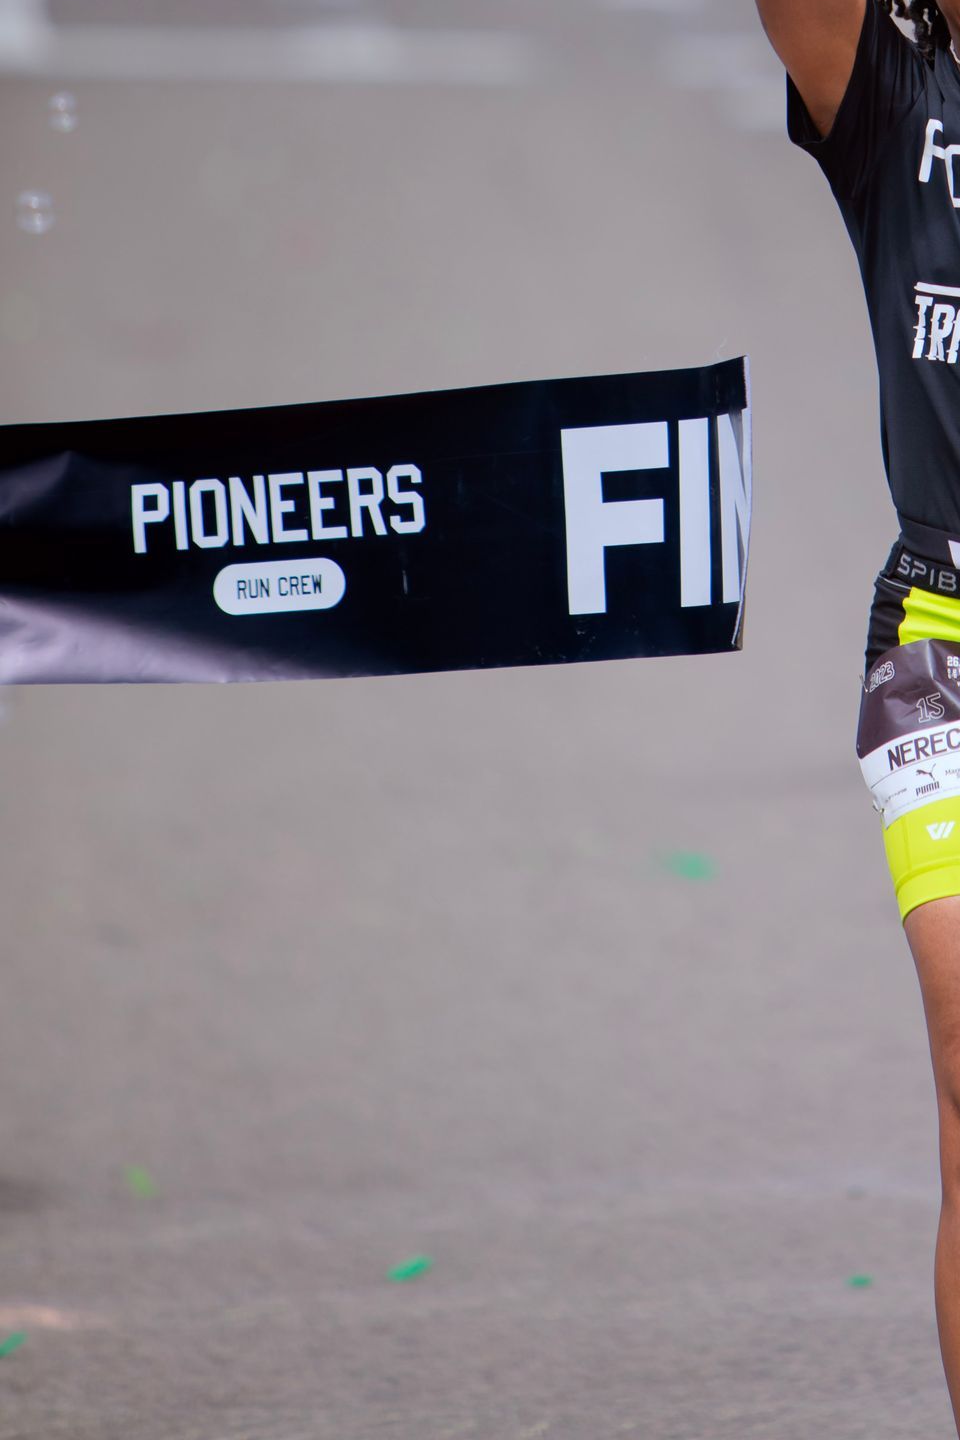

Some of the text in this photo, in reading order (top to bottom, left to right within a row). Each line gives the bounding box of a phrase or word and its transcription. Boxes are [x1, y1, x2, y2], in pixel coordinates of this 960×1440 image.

[131, 463, 426, 554] PIONEERS
[236, 574, 324, 600] RUN CREW
[915, 691, 945, 724] 15
[915, 780, 940, 797] PUMA
